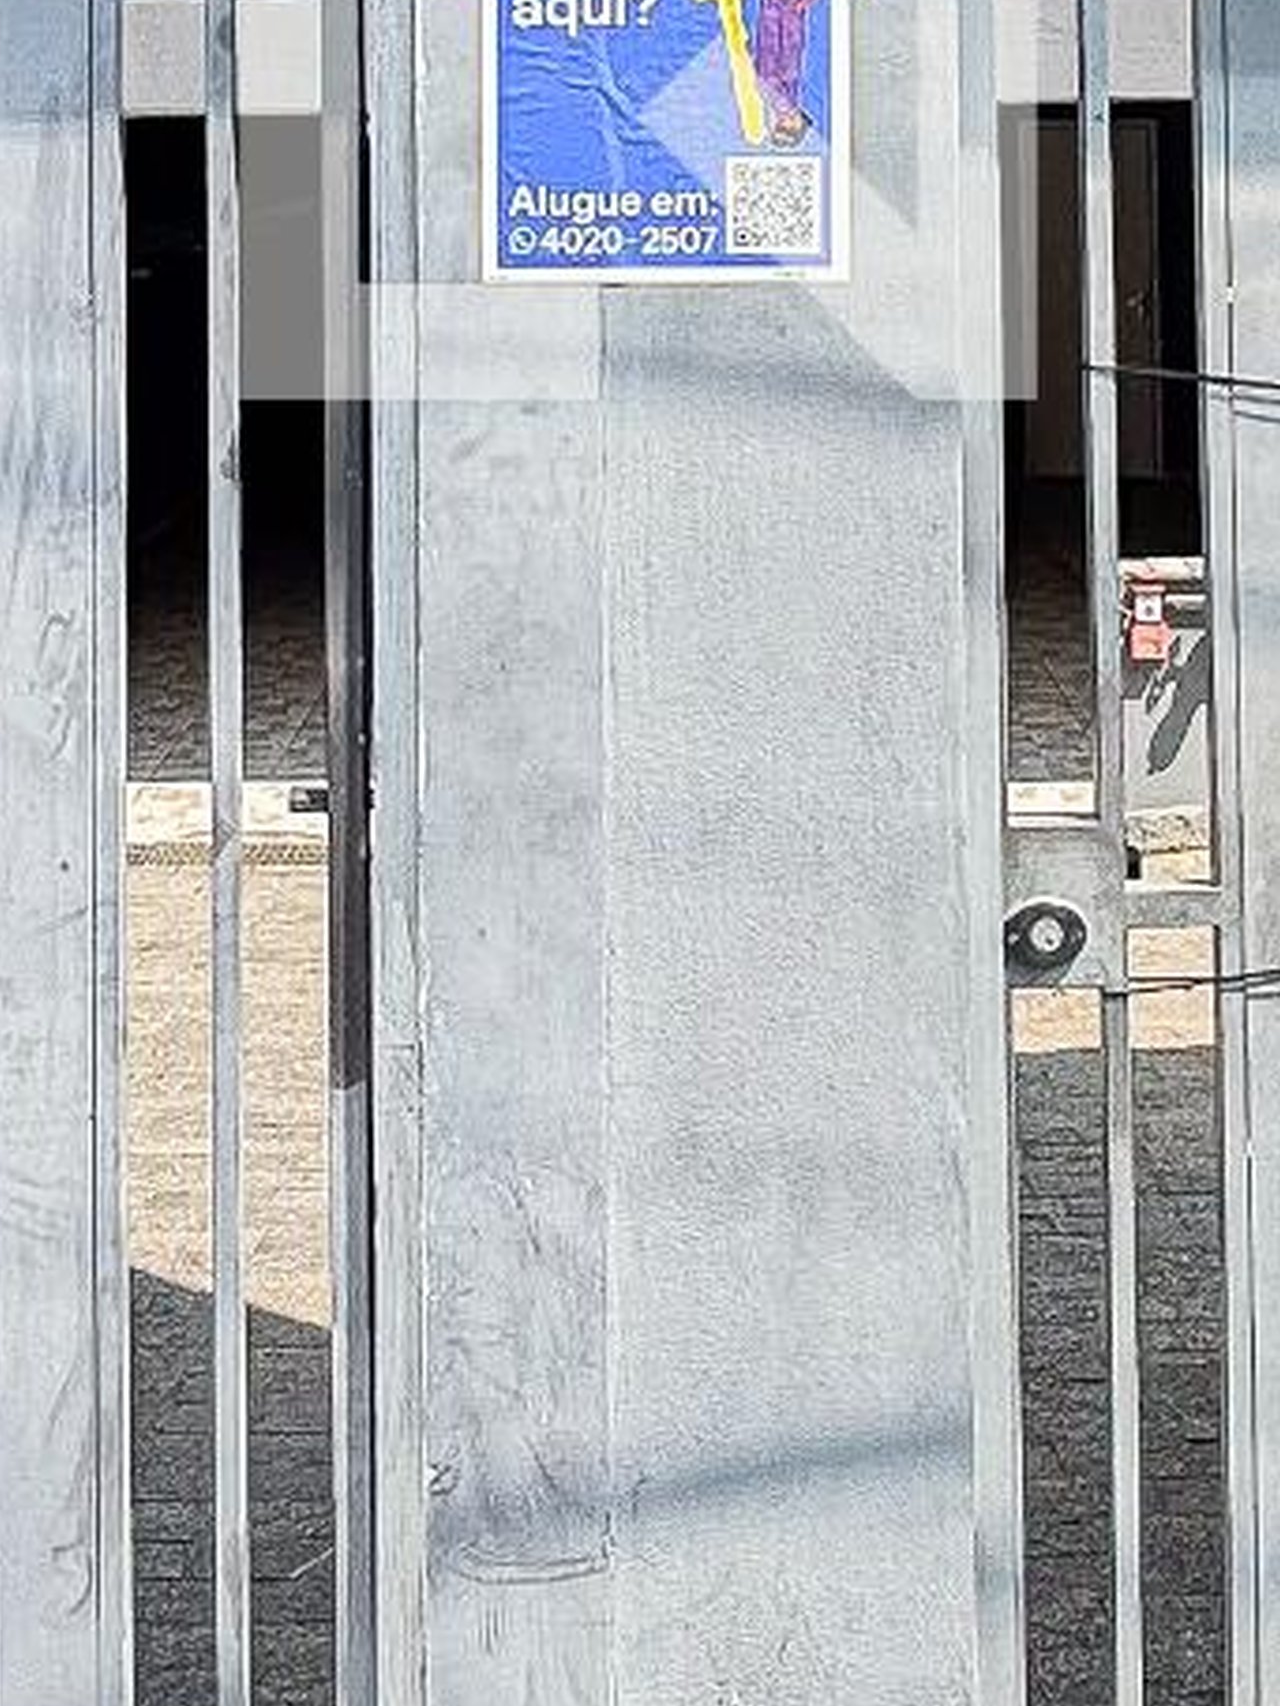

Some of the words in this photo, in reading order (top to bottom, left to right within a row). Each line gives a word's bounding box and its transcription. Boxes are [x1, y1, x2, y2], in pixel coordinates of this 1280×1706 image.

[508, 186, 642, 224] Alugue
[649, 193, 720, 219] em:
[540, 228, 719, 256] 4020-2507
